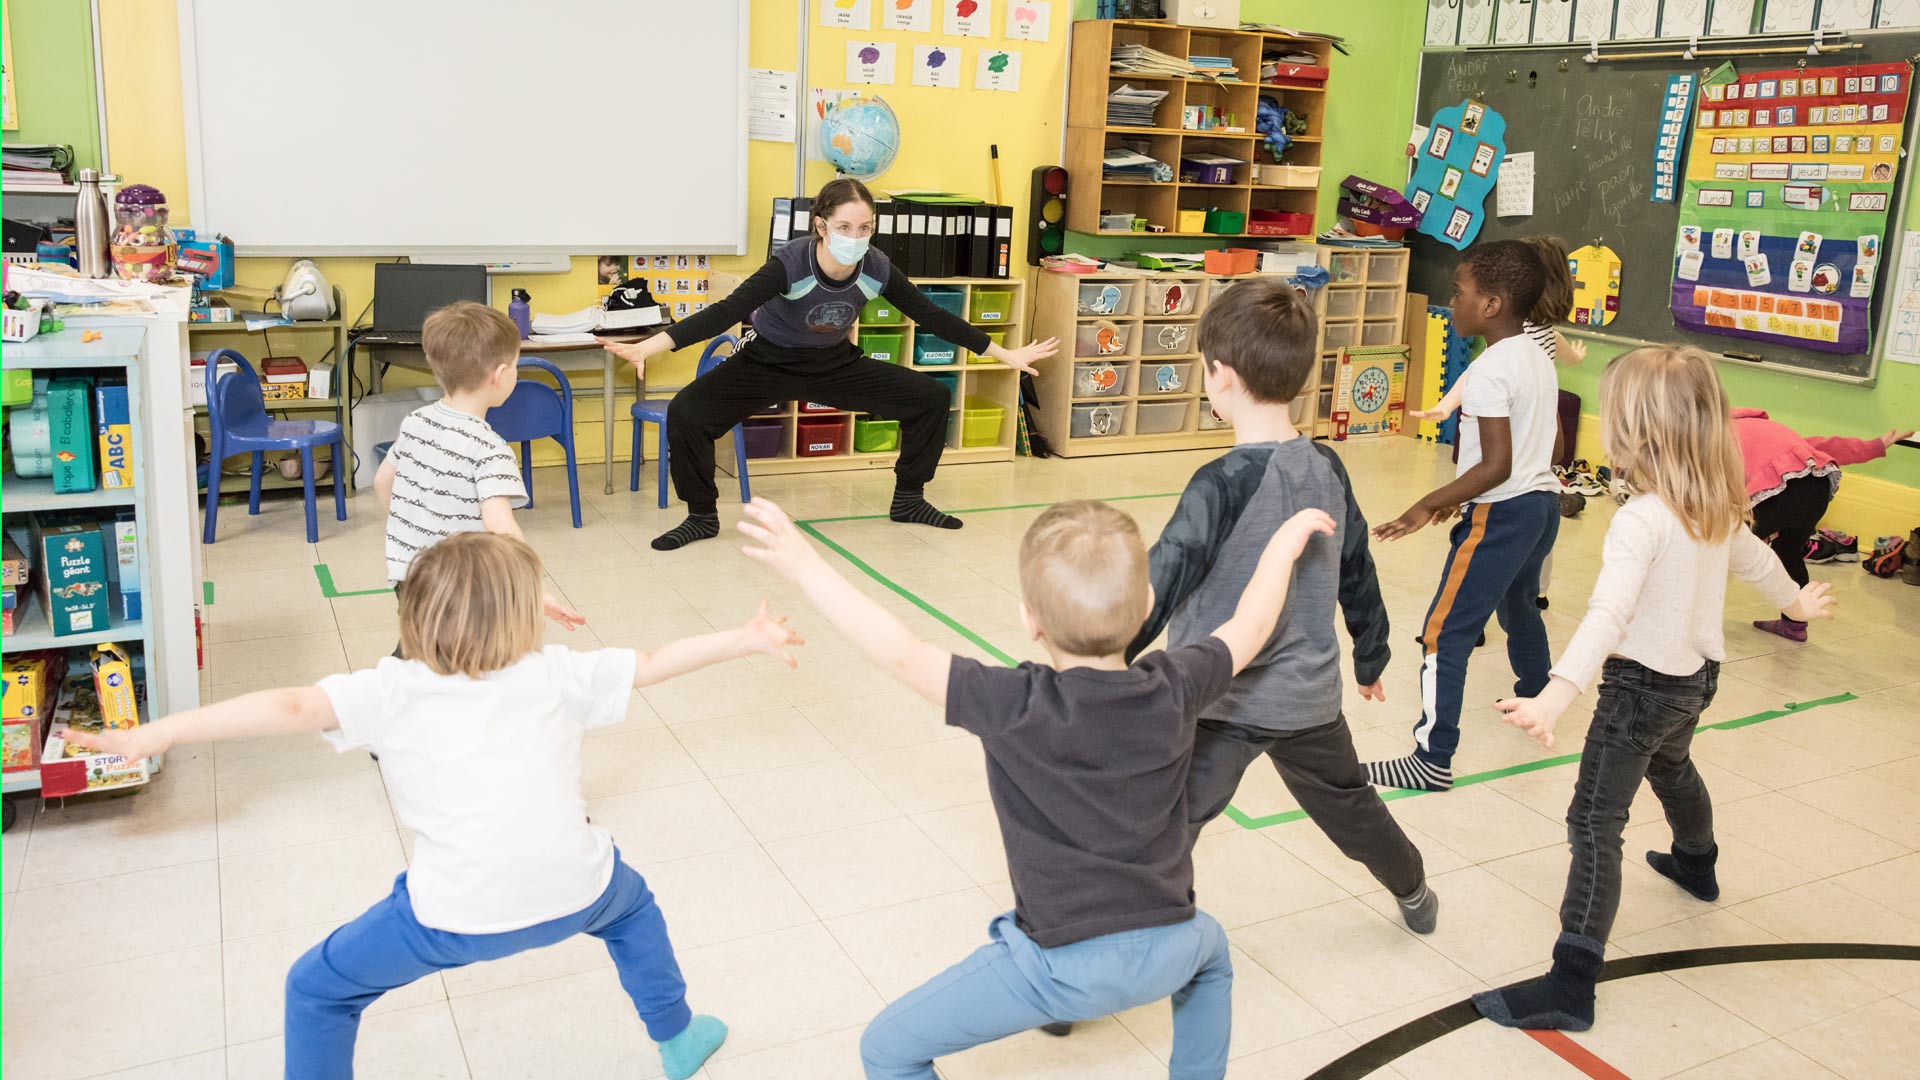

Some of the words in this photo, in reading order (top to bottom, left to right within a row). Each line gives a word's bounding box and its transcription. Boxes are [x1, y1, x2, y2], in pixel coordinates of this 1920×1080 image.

[1729, 86, 1737, 98] 2
[1746, 85, 1754, 96] 3
[1764, 83, 1772, 95] 4
[1785, 82, 1794, 94] 5
[1805, 81, 1814, 93] 6
[1824, 80, 1833, 93] 7
[1848, 79, 1857, 92] 8
[1864, 78, 1873, 90] 9
[1883, 77, 1896, 90] 10
[1704, 113, 1710, 126] 11
[1722, 112, 1732, 124] 12
[1736, 111, 1746, 124] 13
[1757, 111, 1768, 123] 14
[1780, 110, 1792, 122] 16
[1812, 109, 1823, 121] 17
[1829, 109, 1839, 121] 18
[1843, 108, 1854, 120] 19
[1875, 107, 1886, 119] 21
[1714, 140, 1723, 151] 15
[1726, 140, 1737, 151] 24
[1740, 140, 1751, 151] 23
[1756, 140, 1769, 151] 25
[1774, 140, 1787, 151] 26
[1791, 140, 1805, 151] 27
[1814, 139, 1826, 151] 28
[1836, 139, 1849, 150] 29
[1857, 139, 1871, 150] 30
[1882, 138, 1892, 149] 31
[1716, 165, 1747, 177] mardi
[1795, 166, 1823, 179] jeudi
[1749, 194, 1762, 205] 22
[1855, 195, 1882, 209] 2021
[1714, 293, 1722, 304] 2
[1728, 295, 1737, 306] 3
[1745, 297, 1753, 309] 4
[1763, 298, 1770, 309] 5
[1791, 303, 1799, 313] 7
[1803, 324, 1814, 336] 15
[107, 433, 125, 469] ABC
[61, 556, 90, 567] Puzzle
[63, 566, 91, 578] géant
[95, 756, 128, 766] STORY
